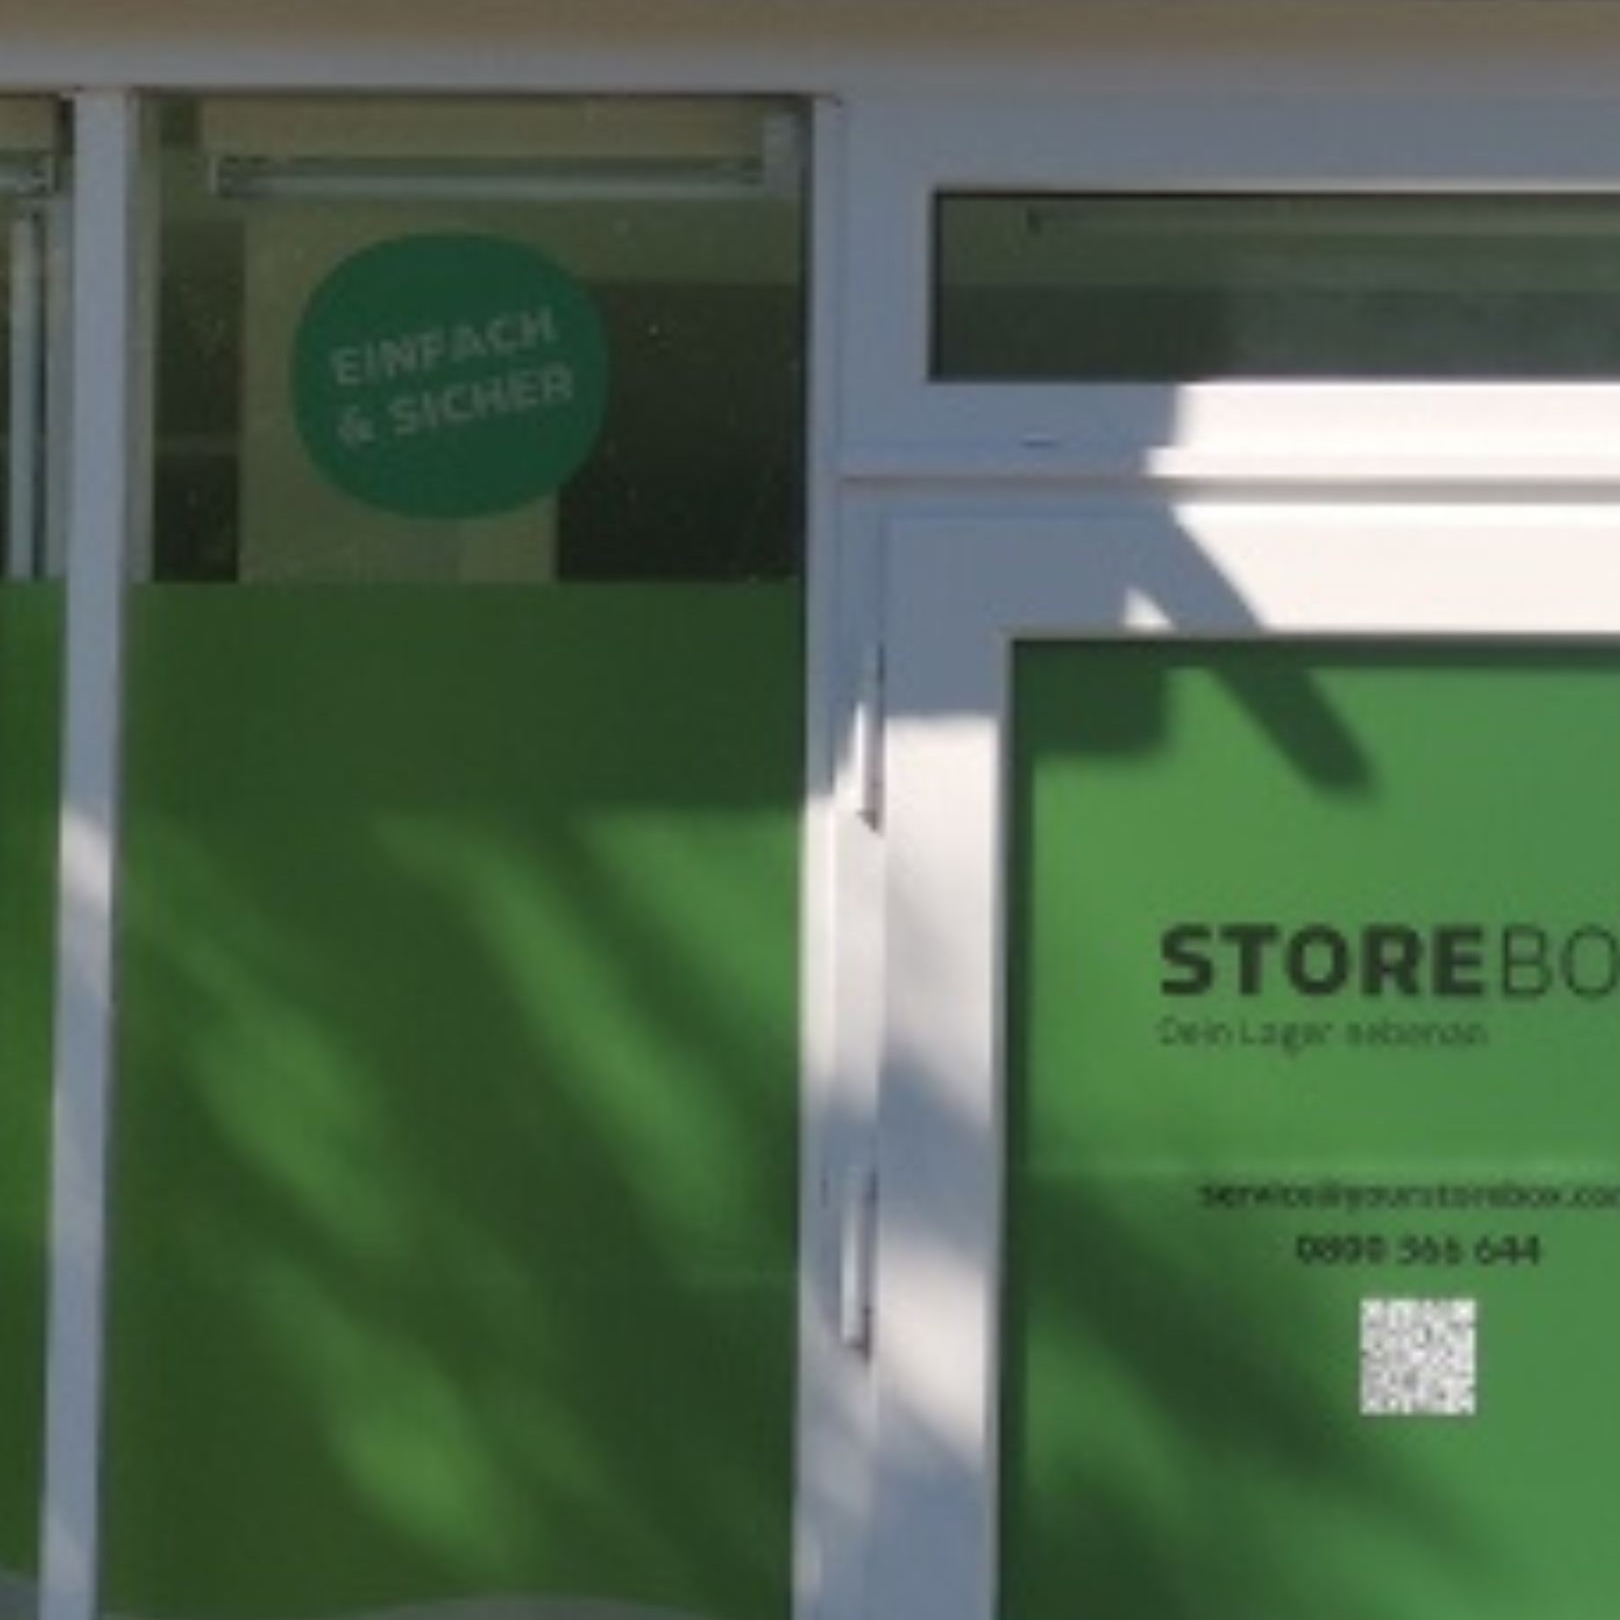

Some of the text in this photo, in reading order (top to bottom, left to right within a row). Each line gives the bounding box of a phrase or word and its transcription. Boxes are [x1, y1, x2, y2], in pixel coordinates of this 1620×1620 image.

[330, 306, 557, 386] EINFACH
[337, 361, 573, 448] & SICHER
[1240, 1018, 1334, 1058] Lager
